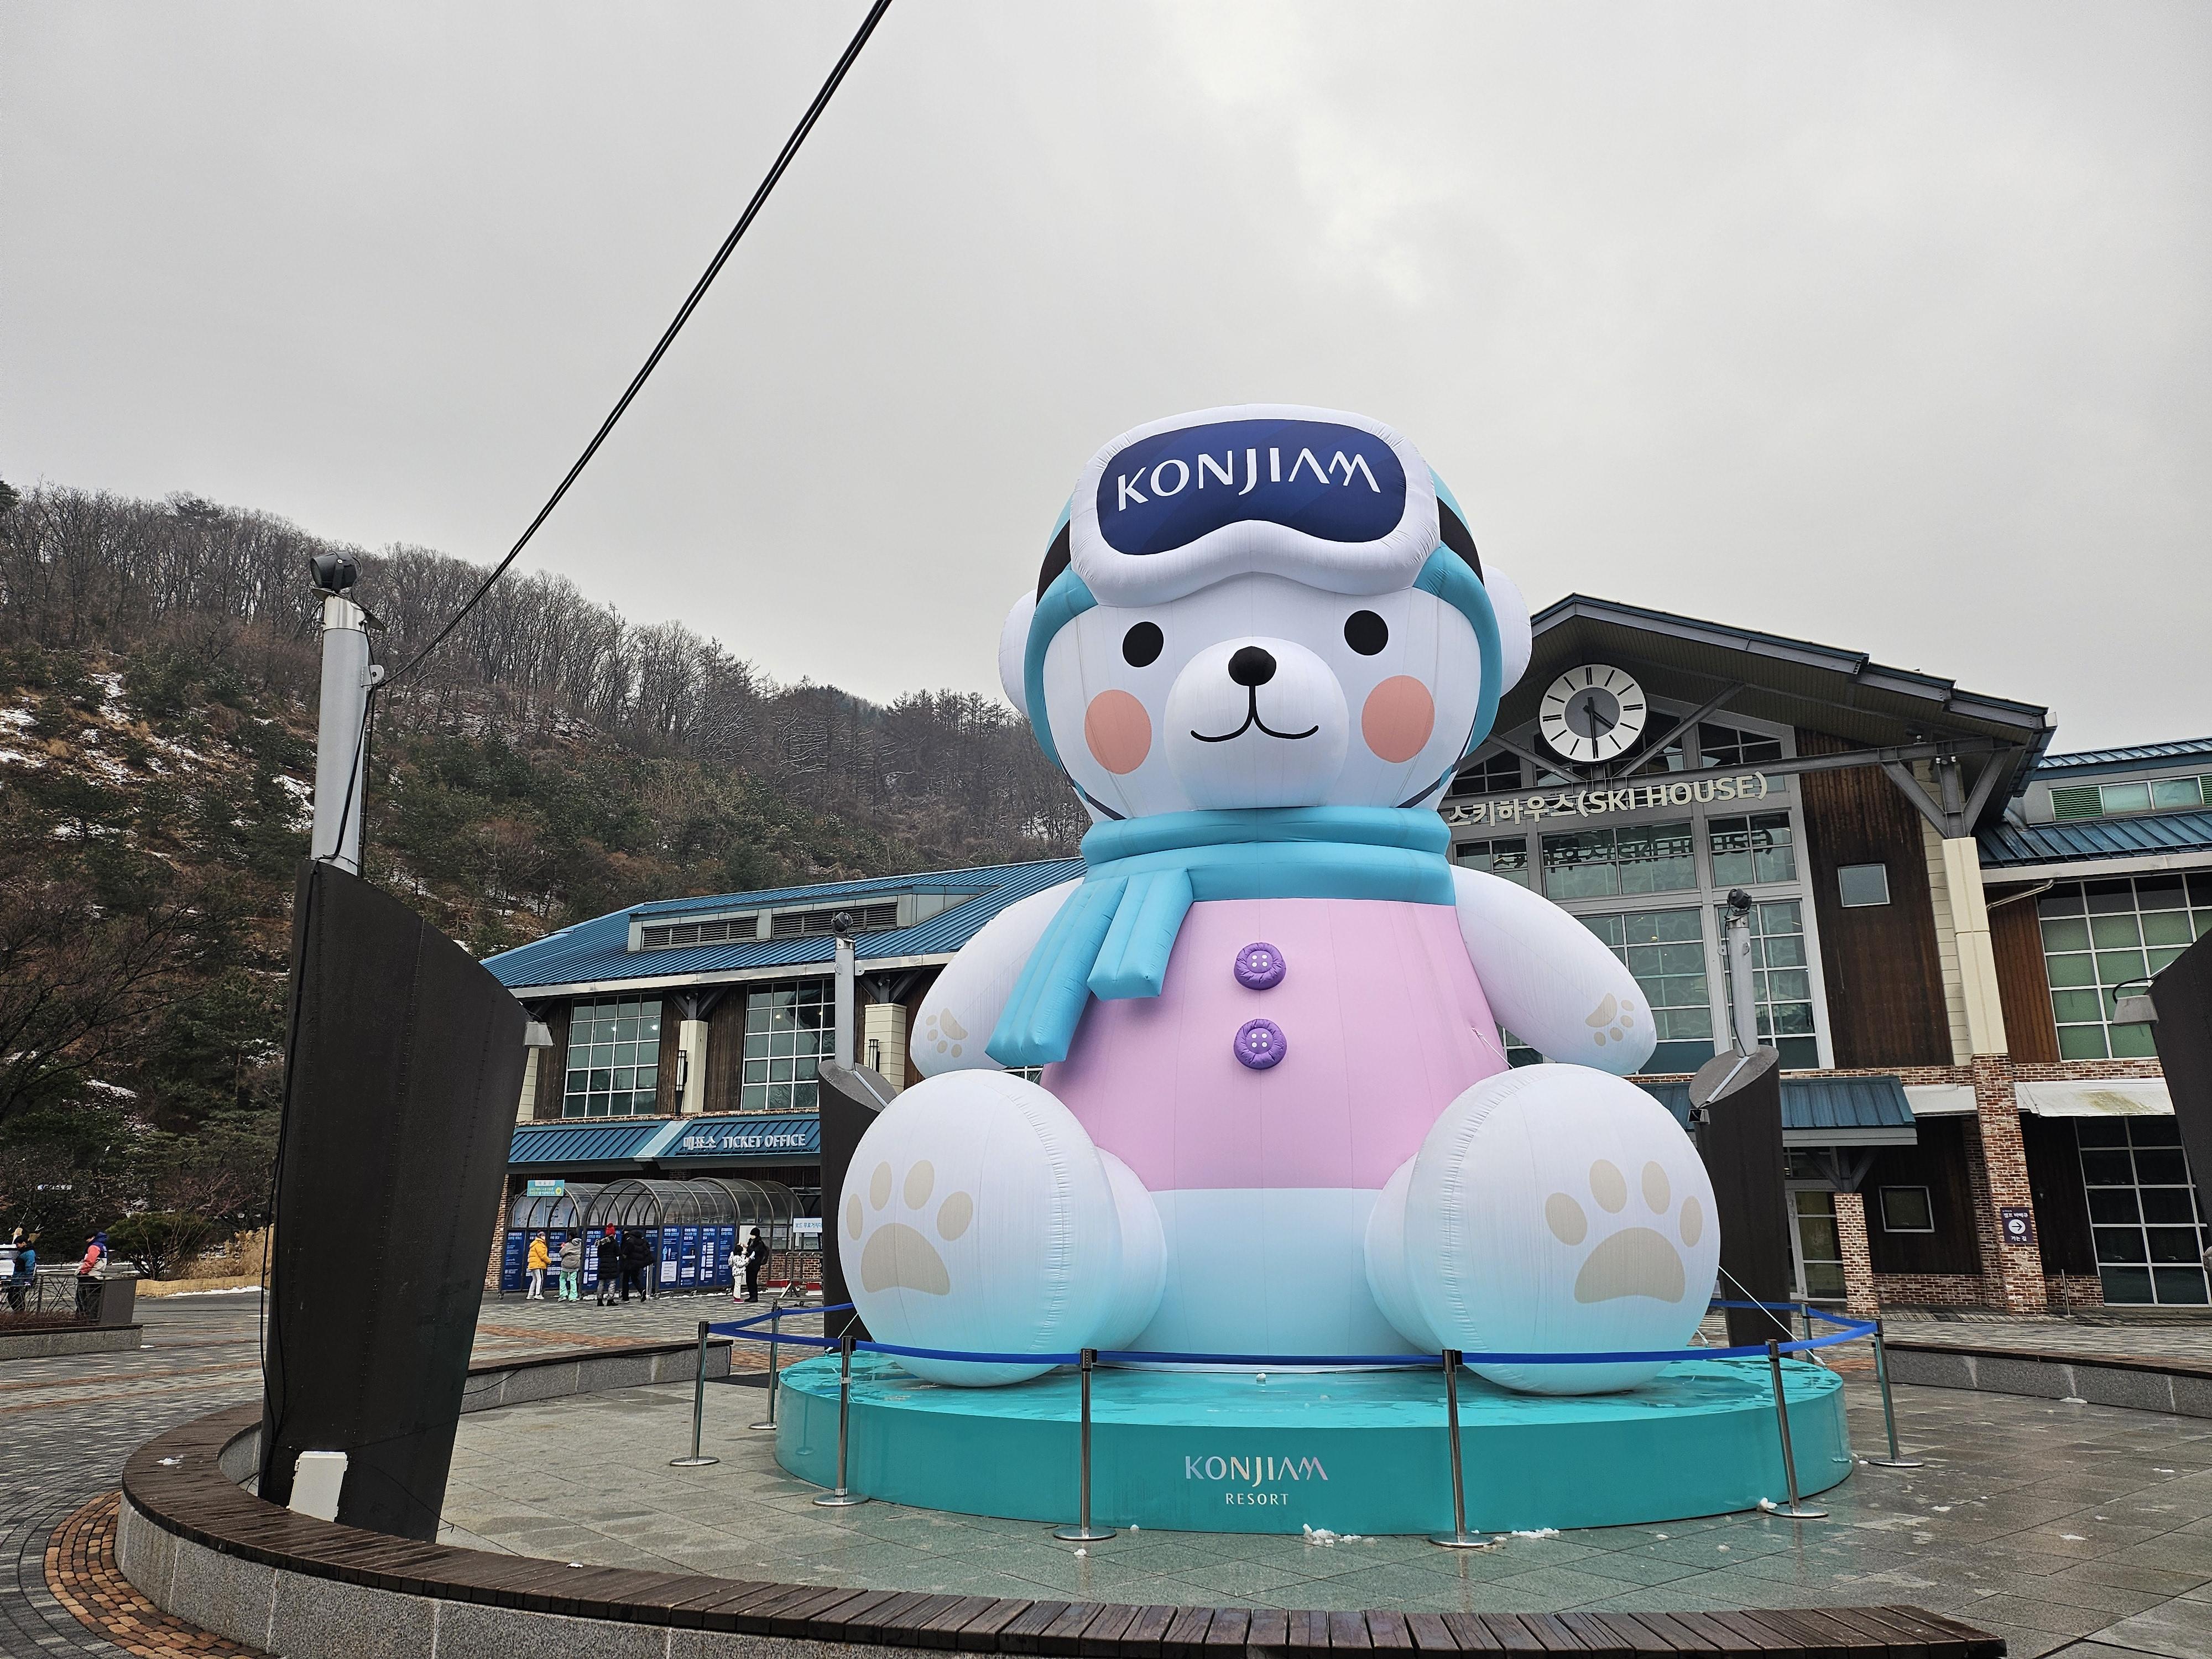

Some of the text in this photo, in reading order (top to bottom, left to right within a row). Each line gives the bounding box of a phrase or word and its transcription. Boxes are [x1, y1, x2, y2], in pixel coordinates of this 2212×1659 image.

[1117, 447, 1381, 512] KONJIAM
[1447, 771, 1768, 827] 스키하우스(SKI HOUSE)
[683, 1134, 806, 1150] 매표소 TICKET OFFICE
[1185, 1455, 1328, 1488] KONJIAM
[1225, 1493, 1289, 1505] RESORT
